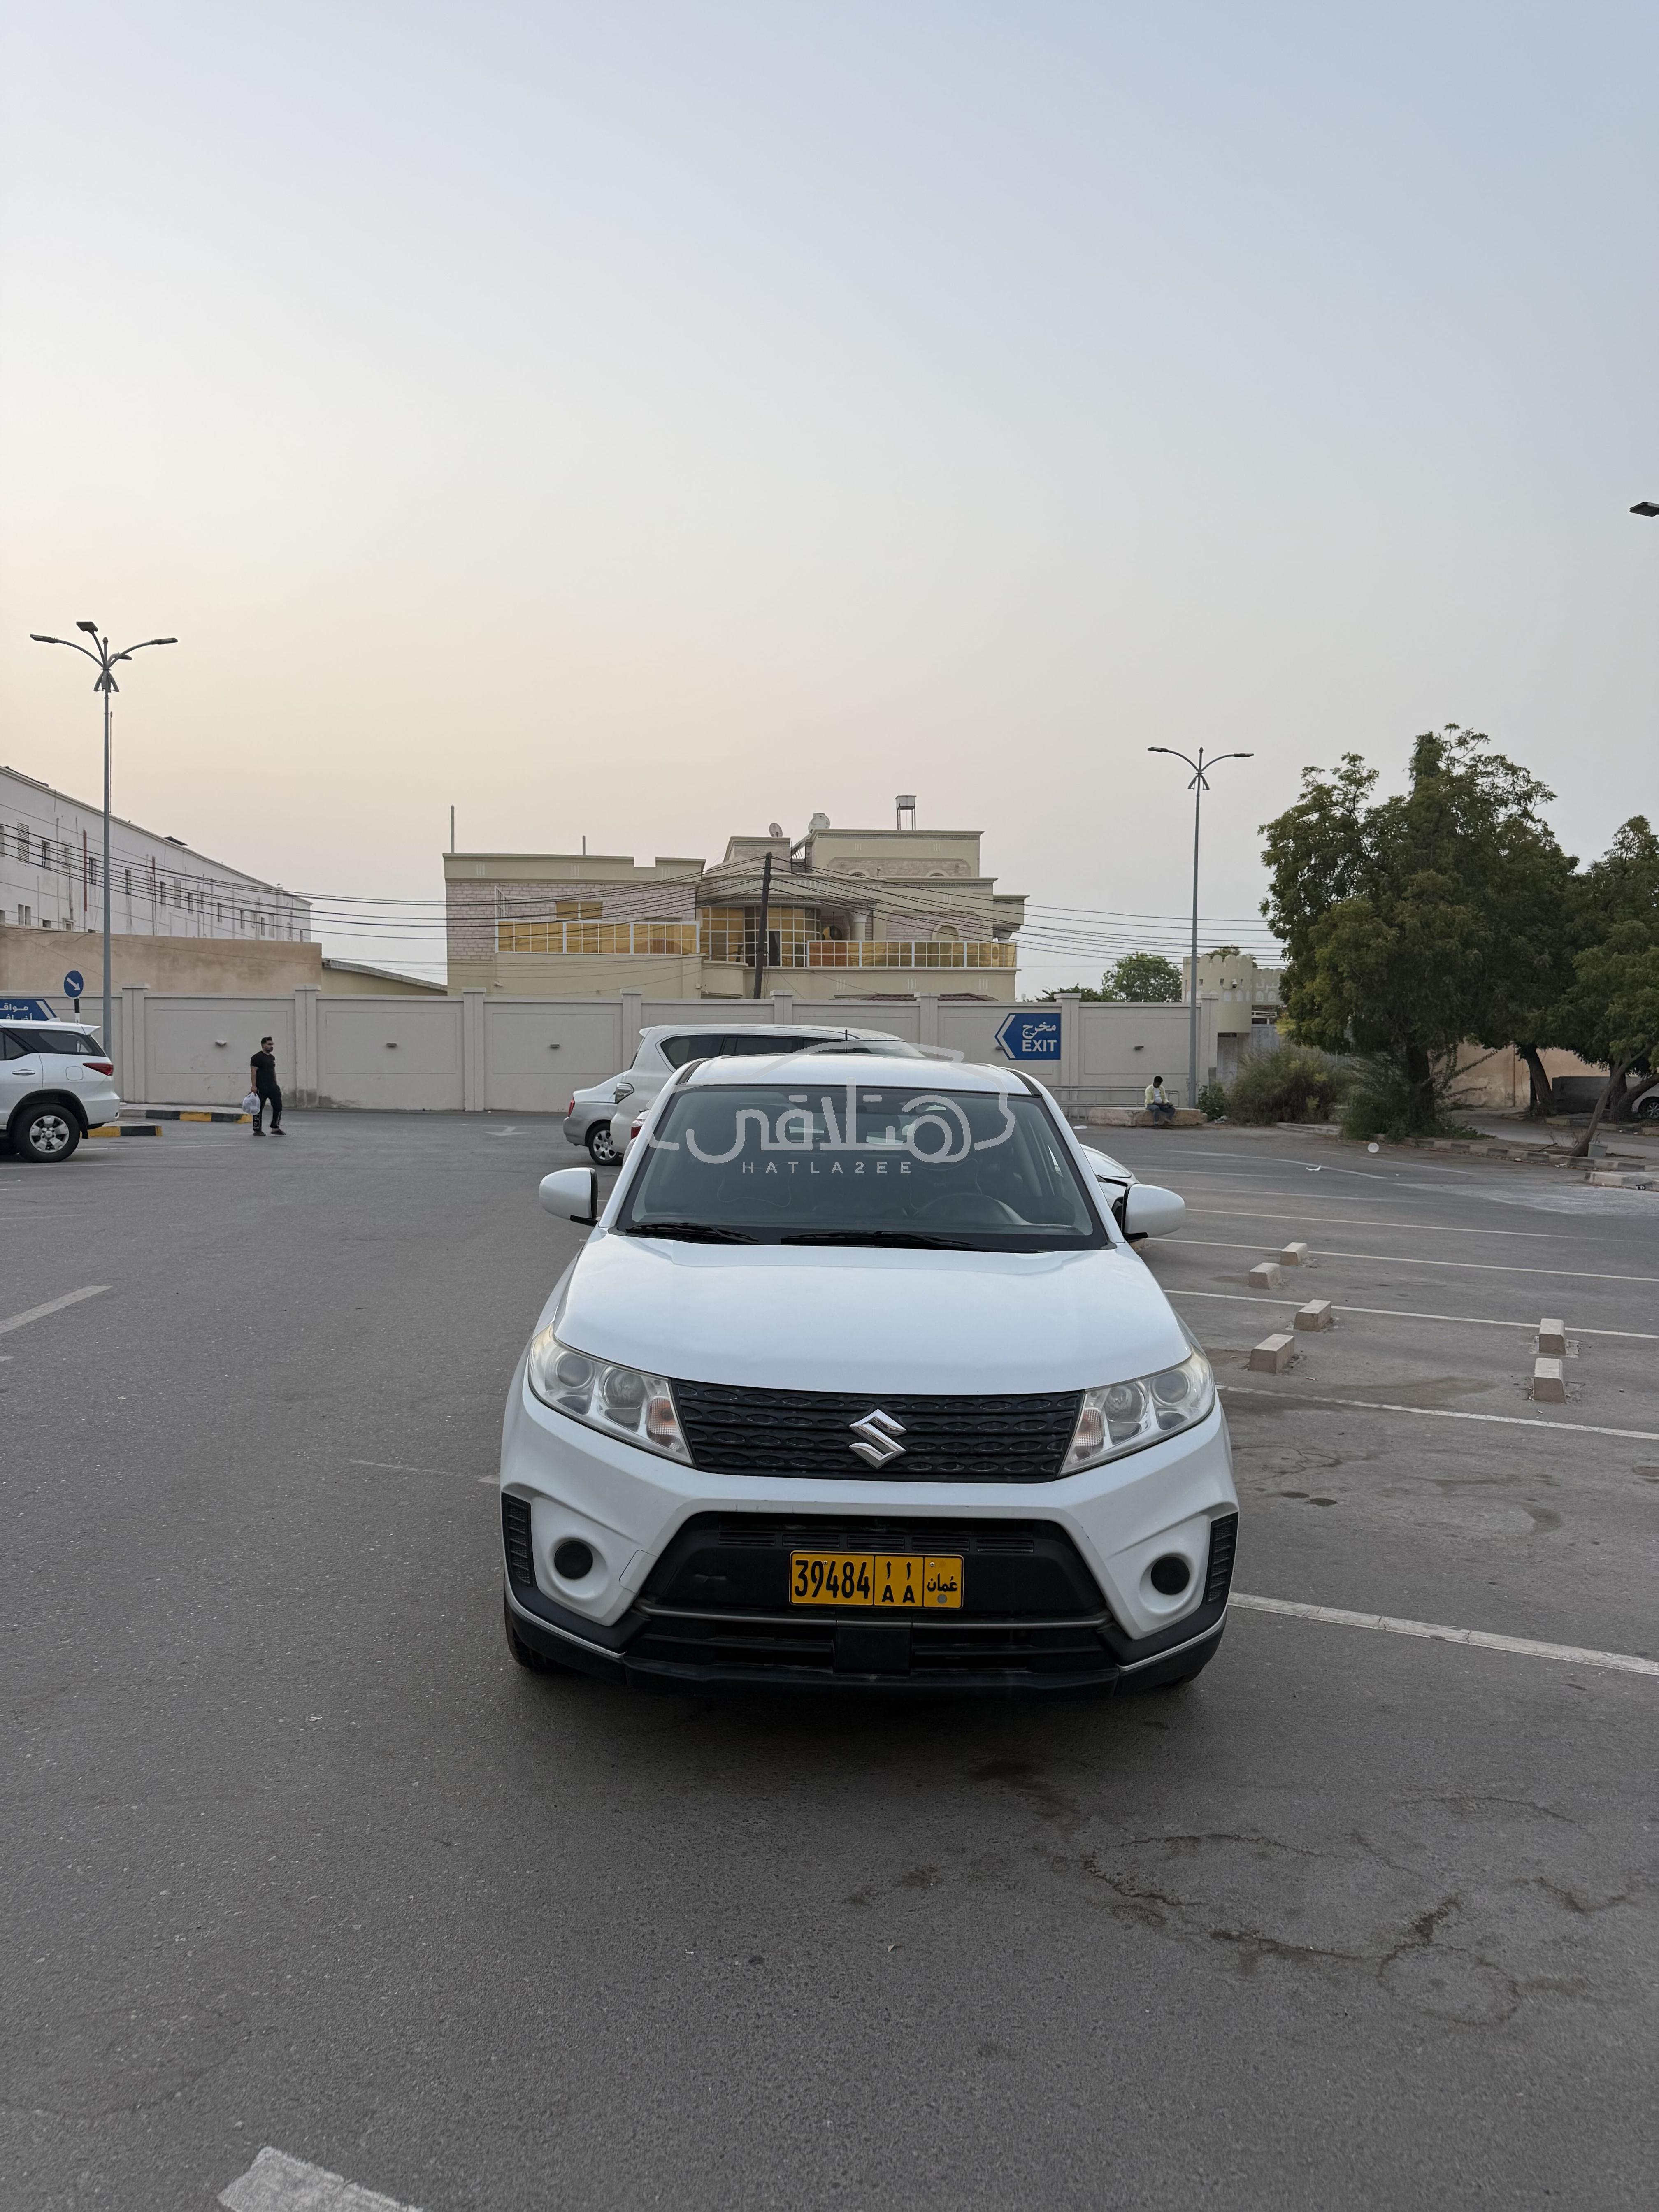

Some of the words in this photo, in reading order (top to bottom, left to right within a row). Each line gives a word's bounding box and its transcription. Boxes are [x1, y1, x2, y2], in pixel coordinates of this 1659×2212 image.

[0, 1003, 28, 1012] مواق
[1022, 1022, 1056, 1039] مخرج
[1022, 1040, 1057, 1052] EXIT
[795, 1560, 870, 1599] 39484
